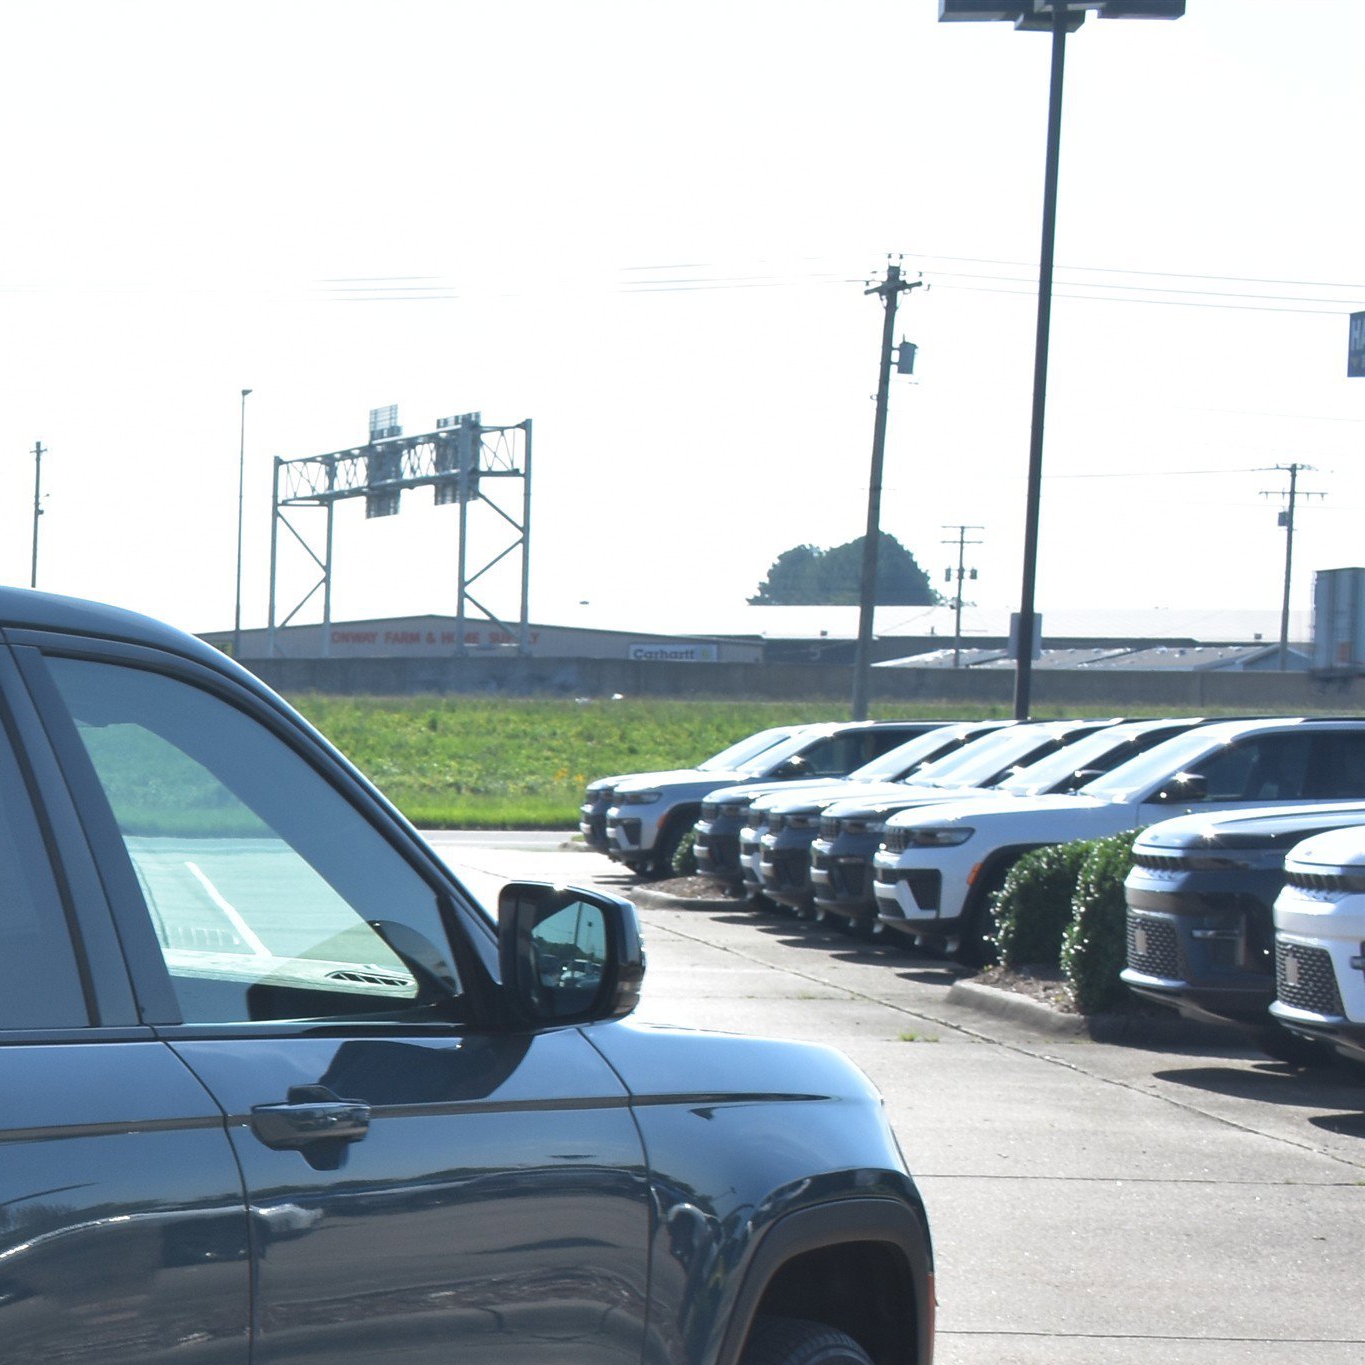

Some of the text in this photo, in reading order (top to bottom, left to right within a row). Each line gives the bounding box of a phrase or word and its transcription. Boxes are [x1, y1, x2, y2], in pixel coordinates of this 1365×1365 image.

[329, 631, 378, 644] ONWAY
[384, 631, 422, 644] FARM
[425, 631, 436, 644] &
[487, 631, 540, 645] SUPY
[633, 648, 695, 661] Carhartt
